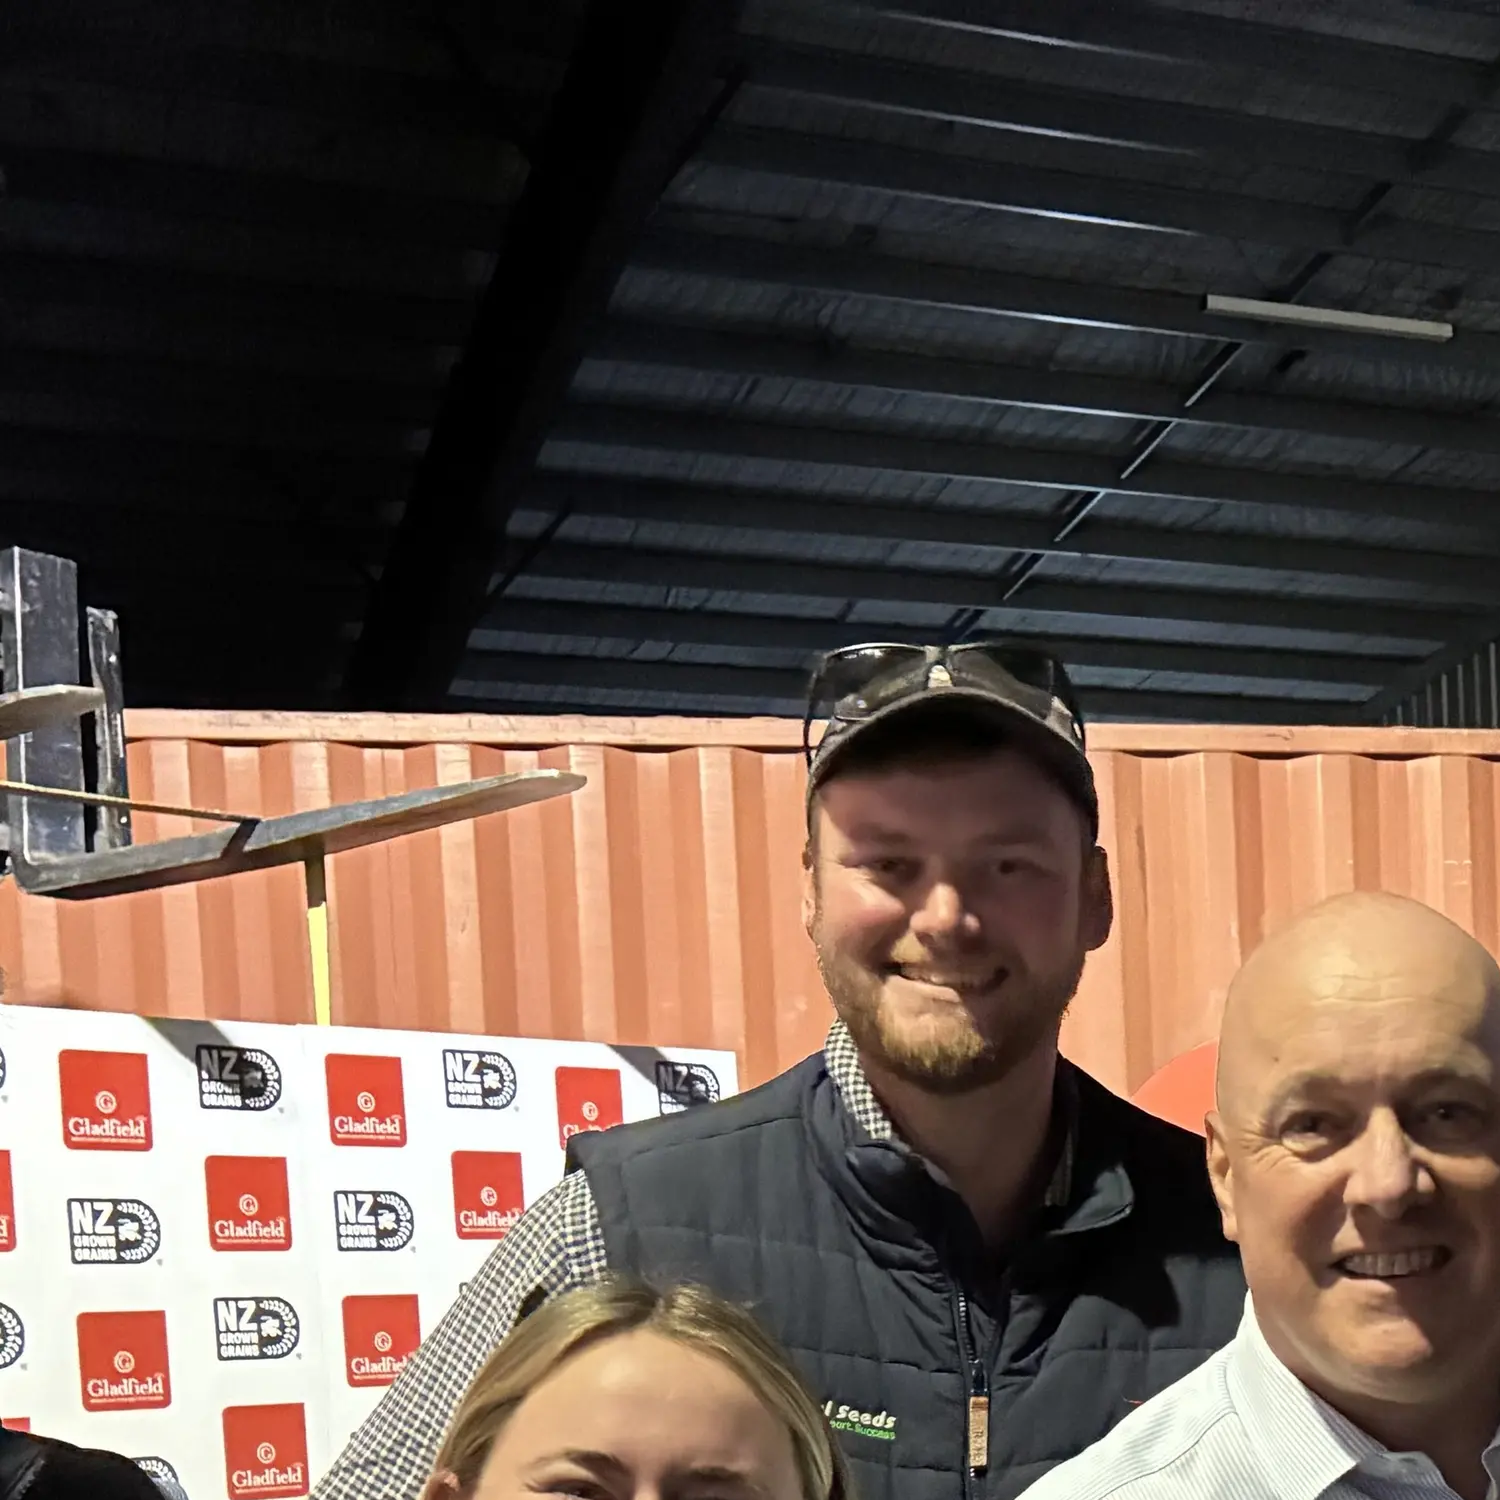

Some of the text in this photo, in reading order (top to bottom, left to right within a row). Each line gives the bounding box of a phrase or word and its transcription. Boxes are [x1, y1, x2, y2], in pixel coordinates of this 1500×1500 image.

[200, 1049, 240, 1081] NZ
[444, 1051, 482, 1082] NZ
[68, 1117, 147, 1138] Gladfield
[334, 1115, 401, 1134] Gladfield
[70, 1201, 116, 1235] NZ
[337, 1193, 375, 1224] NZ
[214, 1220, 285, 1239] Gladfield
[216, 1300, 258, 1332] NZ
[87, 1376, 164, 1398] Gladfield
[836, 1405, 897, 1429] Seeds
[232, 1466, 303, 1487] Gladfield
